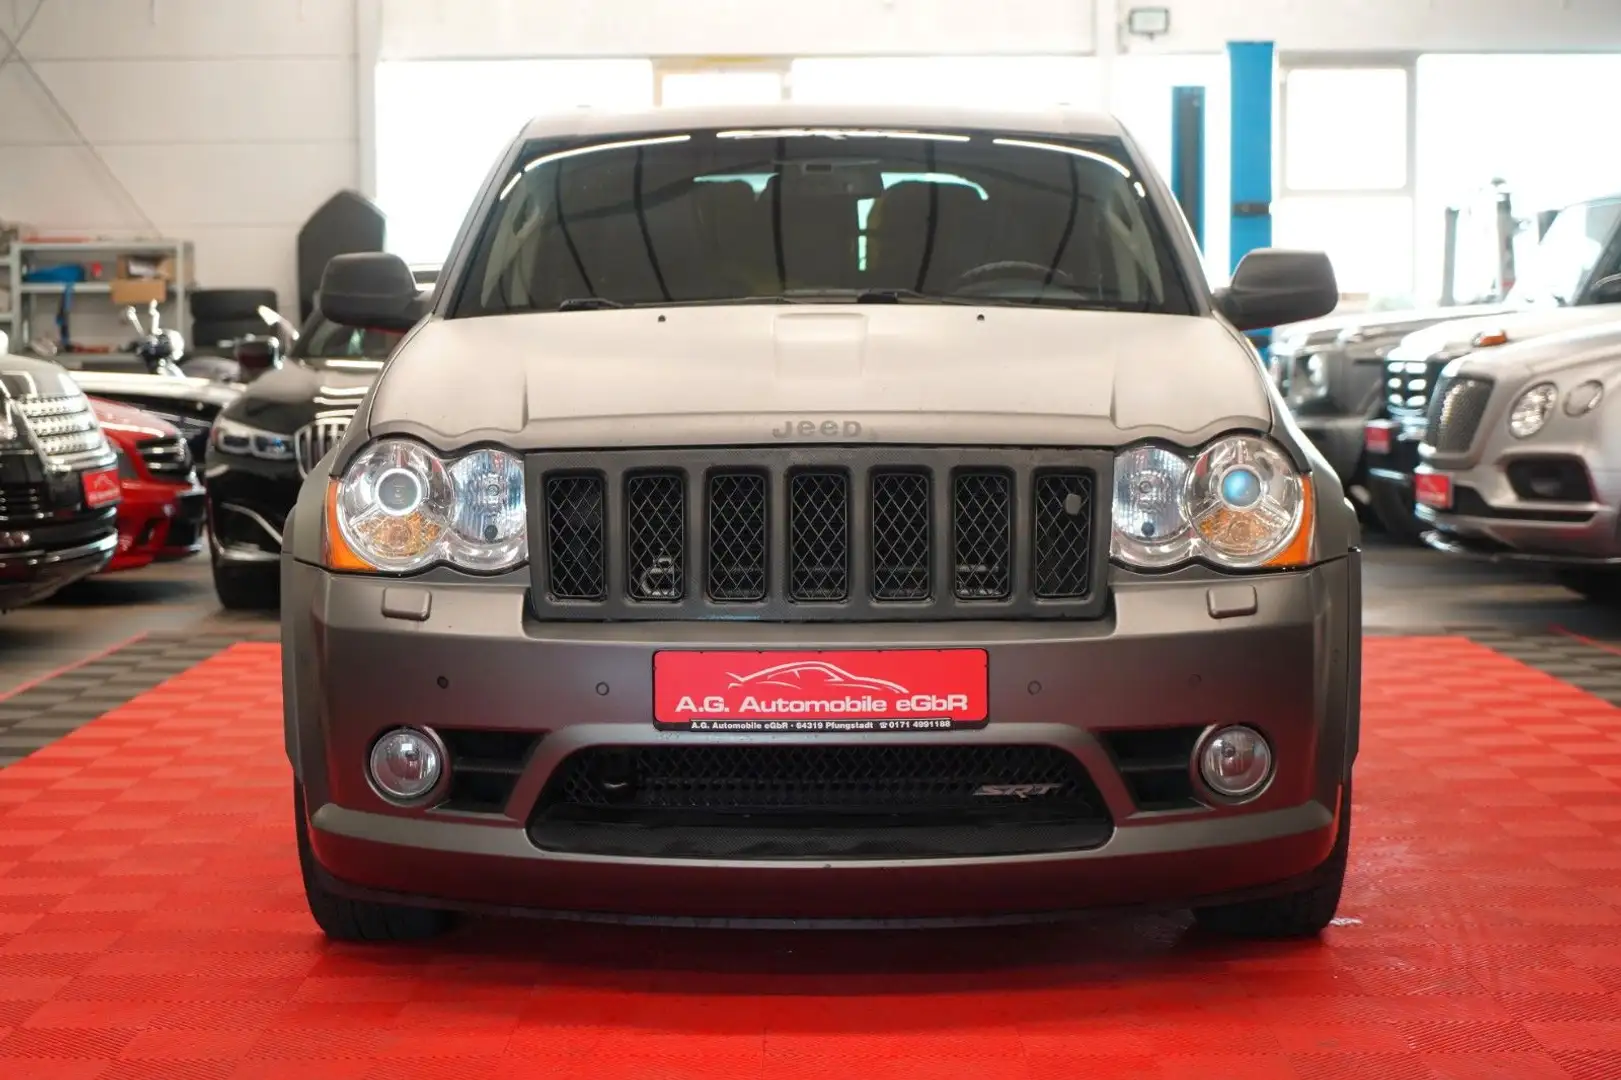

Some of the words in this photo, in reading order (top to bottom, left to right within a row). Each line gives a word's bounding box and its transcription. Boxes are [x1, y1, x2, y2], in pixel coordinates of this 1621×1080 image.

[675, 696, 730, 712] A.G.
[738, 695, 888, 712] Automobile
[895, 694, 968, 712] eGbR
[691, 721, 710, 729] A.G.
[712, 721, 762, 729] Automobile
[764, 721, 788, 729] eGbR
[825, 721, 874, 730] Pfungstadt
[972, 783, 1063, 799] SRT
